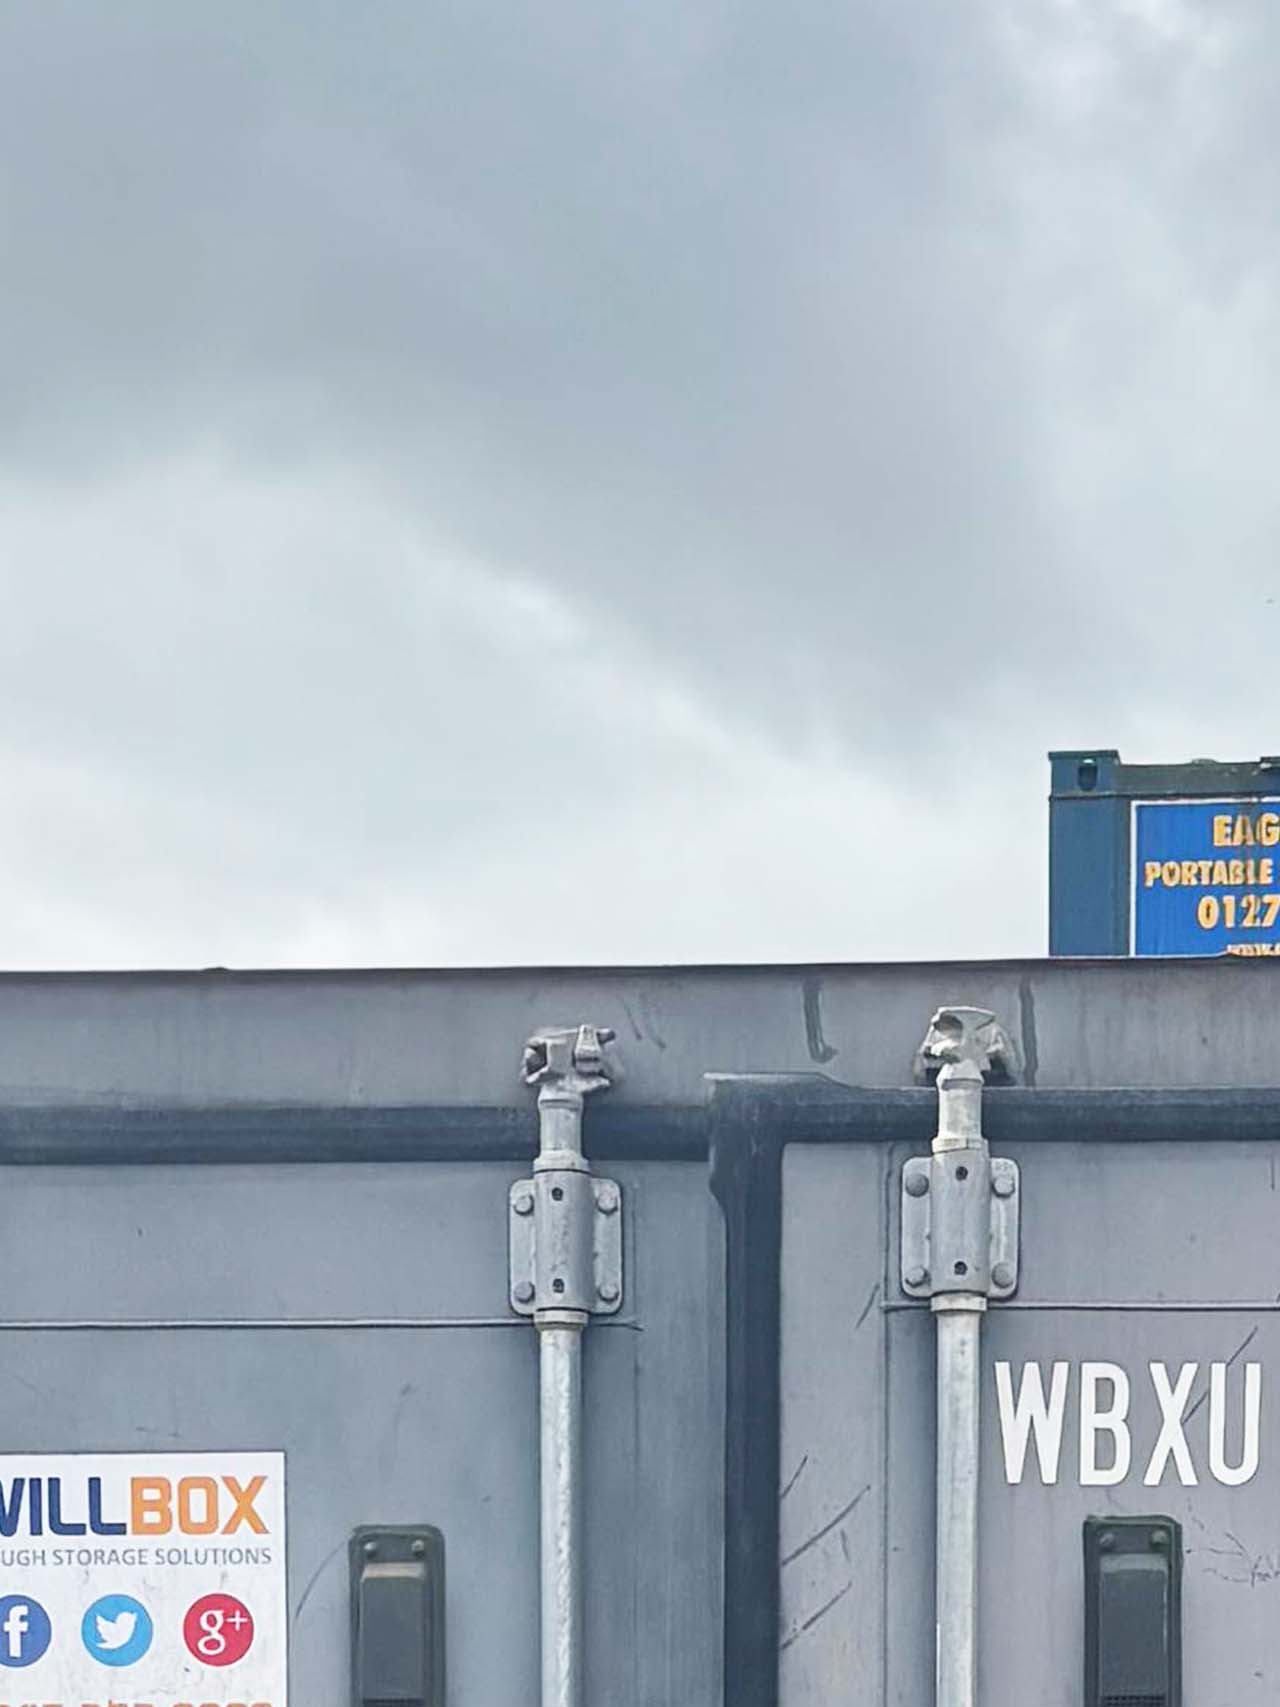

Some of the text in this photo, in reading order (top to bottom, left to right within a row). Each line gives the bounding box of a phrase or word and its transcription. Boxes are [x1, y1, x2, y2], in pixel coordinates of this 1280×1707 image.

[1144, 858, 1273, 887] PORTABLE
[995, 1360, 1262, 1487] WBXU
[53, 1549, 148, 1567] STORAGE
[155, 1548, 272, 1566] SOLUTIONS
